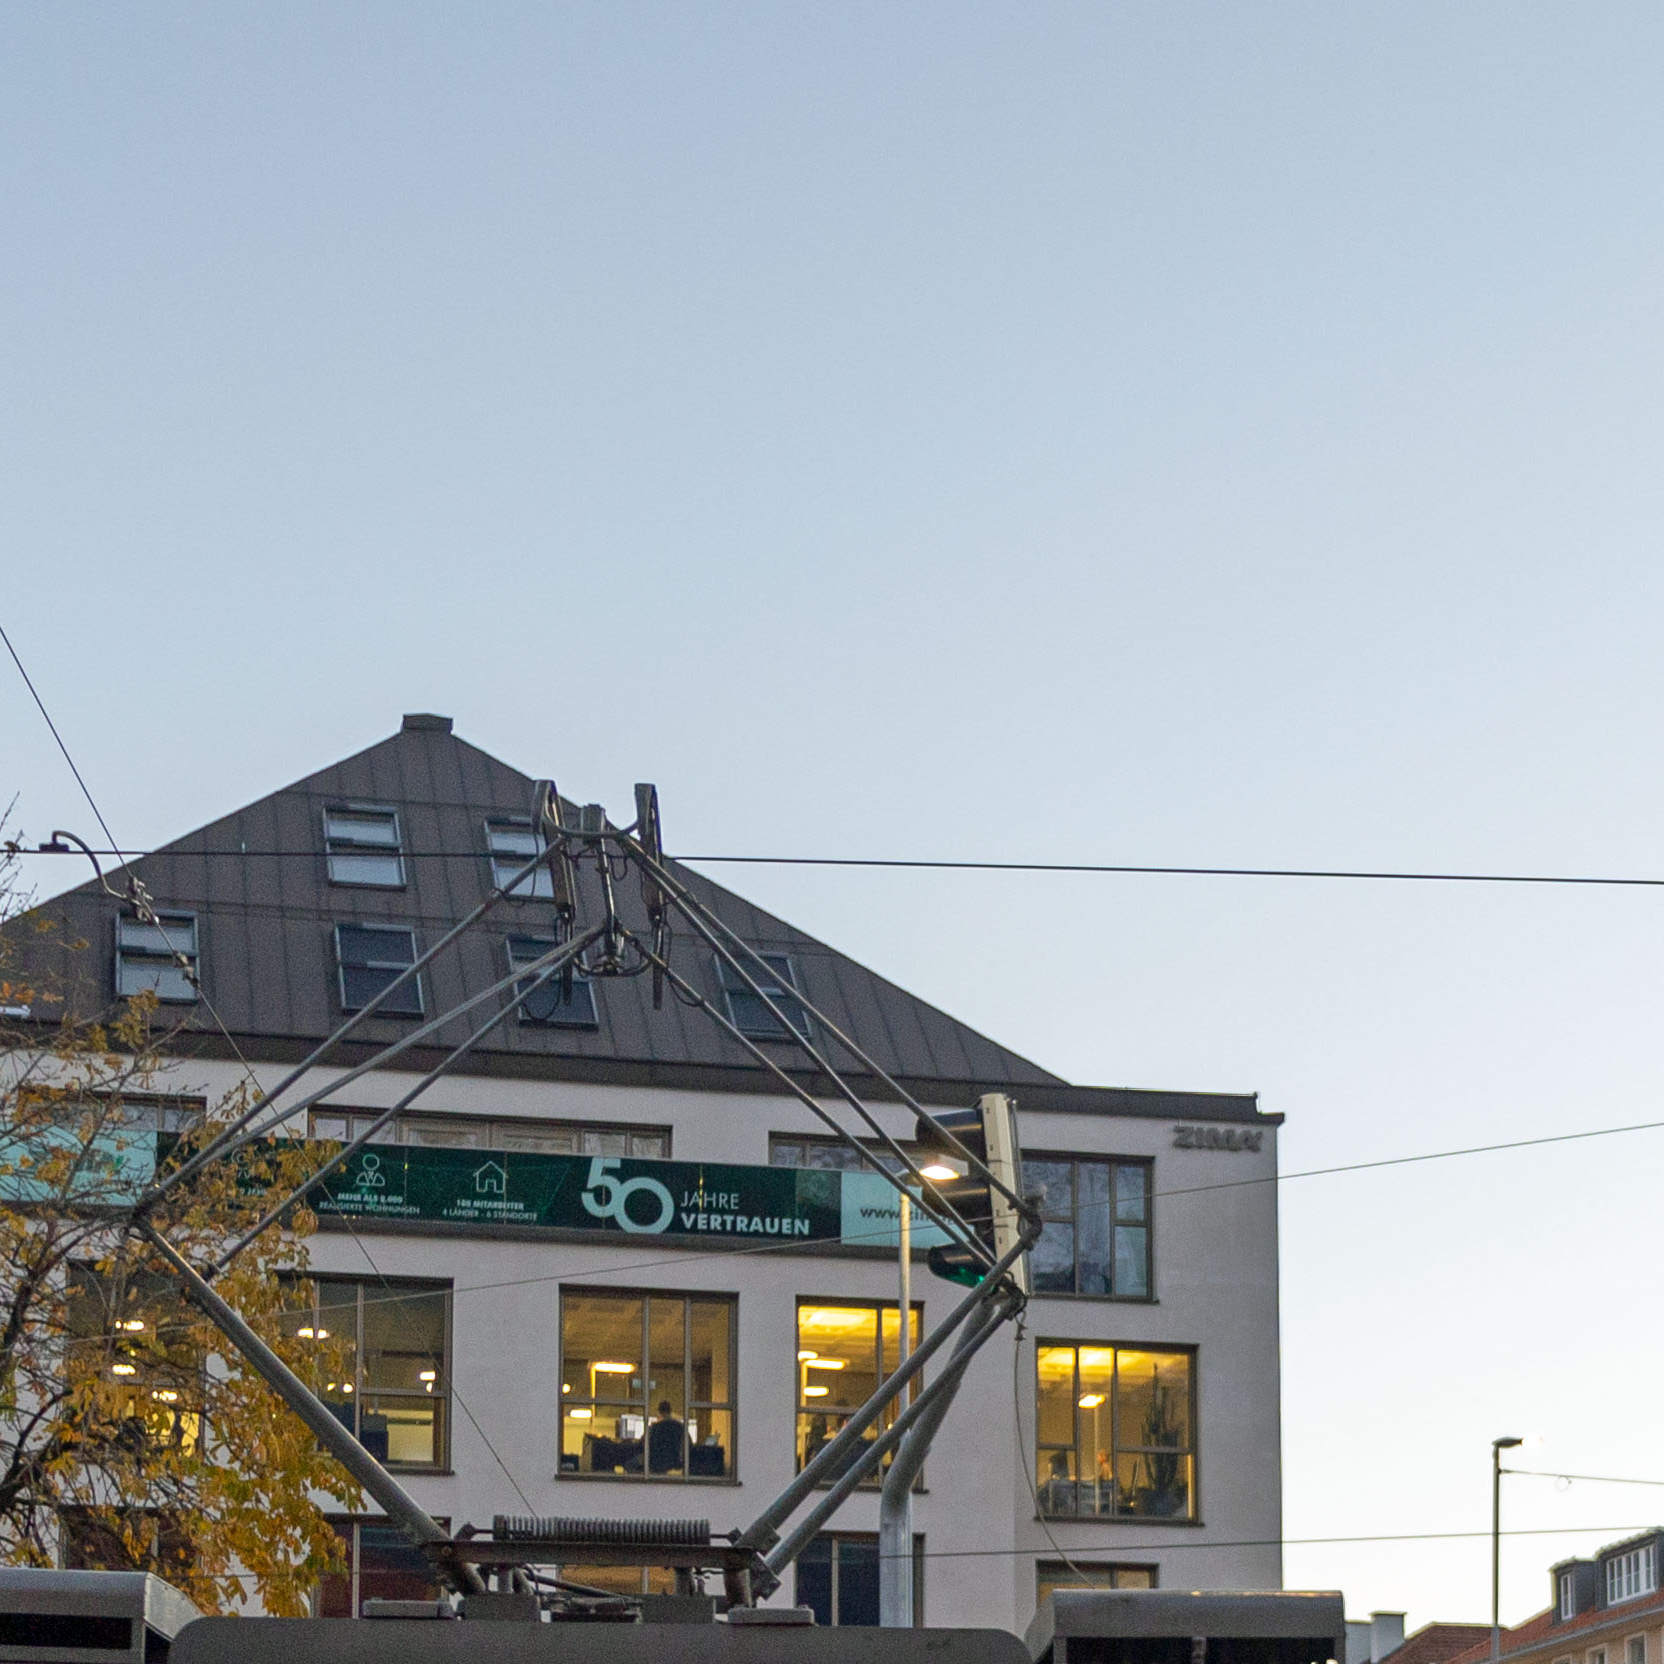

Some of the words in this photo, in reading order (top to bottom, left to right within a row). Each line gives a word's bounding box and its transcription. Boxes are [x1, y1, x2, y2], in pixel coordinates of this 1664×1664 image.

[581, 1158, 675, 1234] 50
[681, 1190, 739, 1211] JAHRE
[365, 1203, 420, 1215] WOHNUNGEN
[449, 1206, 480, 1218] LÄNDER
[493, 1209, 538, 1222] STANDORTE
[473, 1200, 525, 1211] MITARBEITER
[681, 1213, 810, 1236] VERTRAUEN
